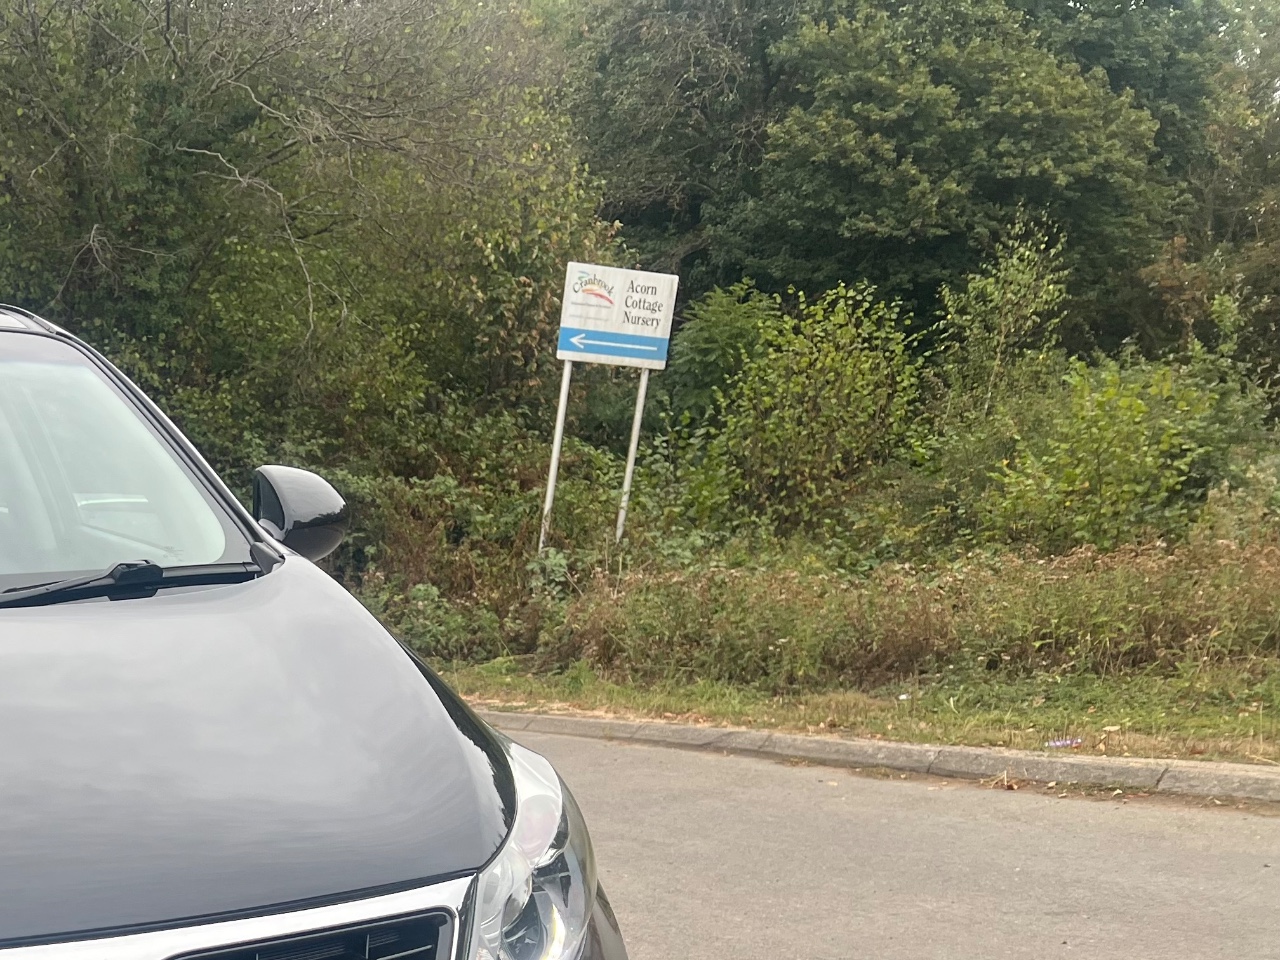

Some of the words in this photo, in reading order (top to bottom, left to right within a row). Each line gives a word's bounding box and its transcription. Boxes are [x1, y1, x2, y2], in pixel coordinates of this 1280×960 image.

[572, 273, 615, 297] Cranbrook
[626, 279, 658, 296] Acorn
[624, 294, 664, 313] Cottage
[622, 310, 662, 330] Nursery
